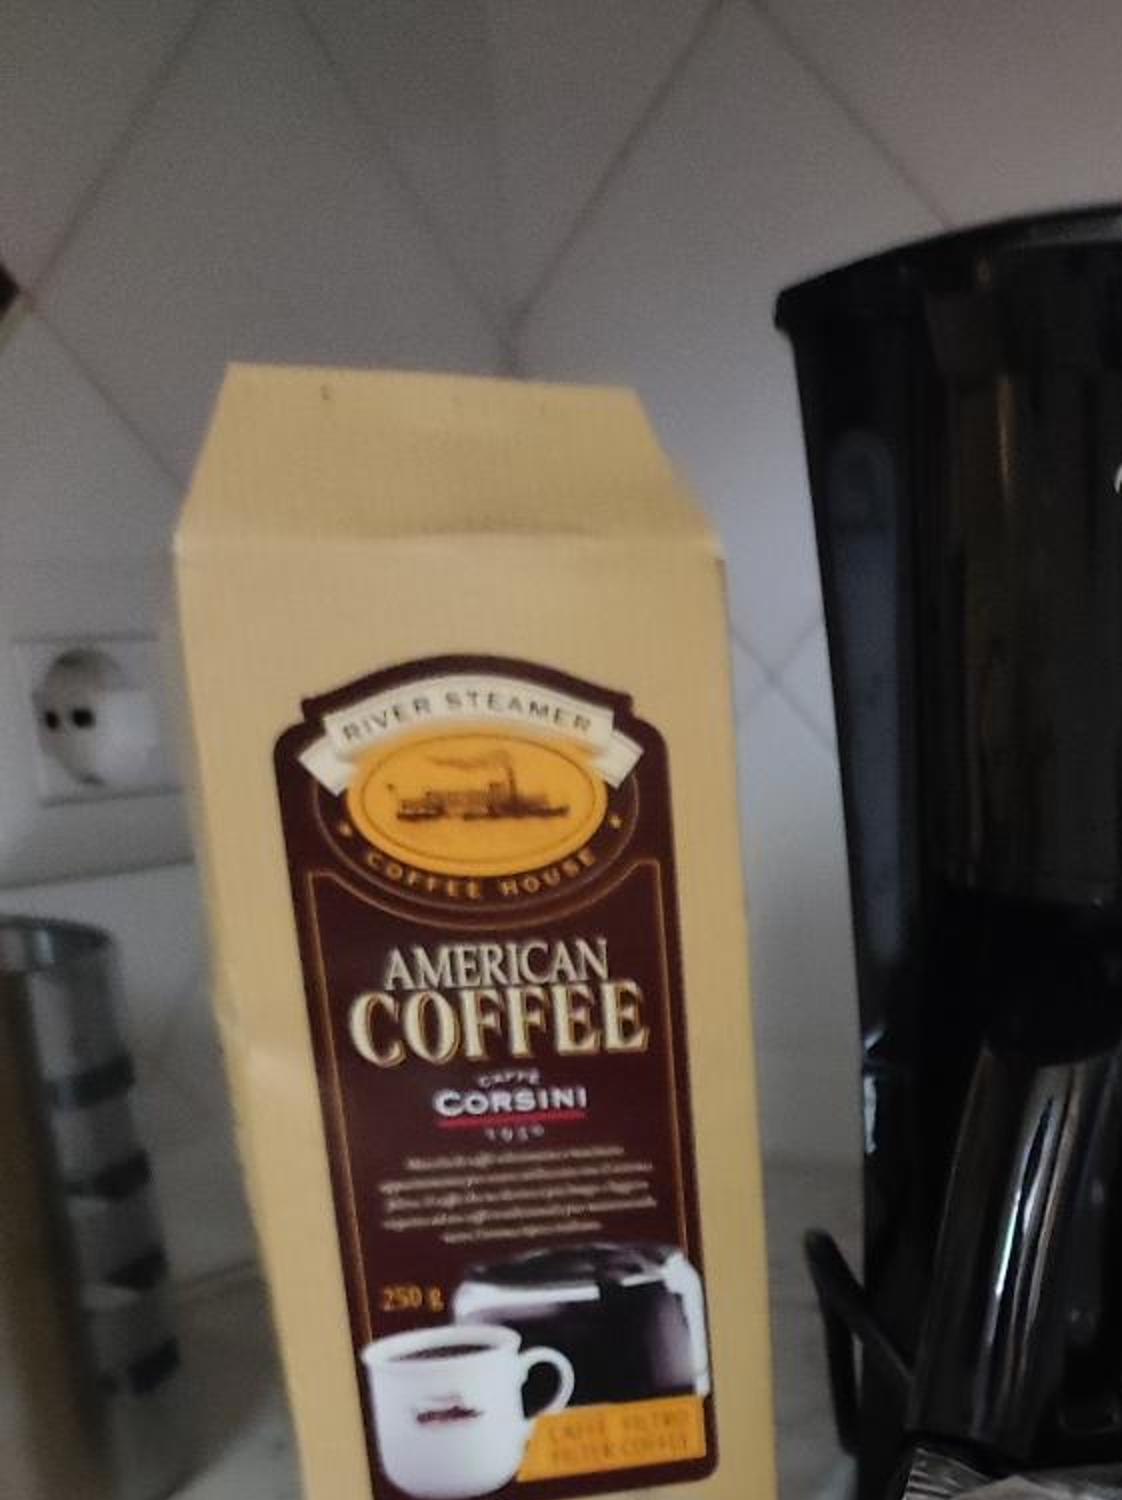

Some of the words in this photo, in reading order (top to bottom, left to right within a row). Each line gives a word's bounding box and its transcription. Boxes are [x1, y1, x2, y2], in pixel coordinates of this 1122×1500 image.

[342, 696, 432, 741] RIVER
[445, 690, 592, 733] STEAMER
[366, 851, 482, 898] COFFEE
[501, 848, 597, 897] HOUSE
[384, 937, 609, 991] AMERICAN
[350, 978, 651, 1068] COFFEE
[432, 1086, 587, 1117] CORSINI
[381, 1284, 423, 1312] 250
[429, 1286, 445, 1312] g
